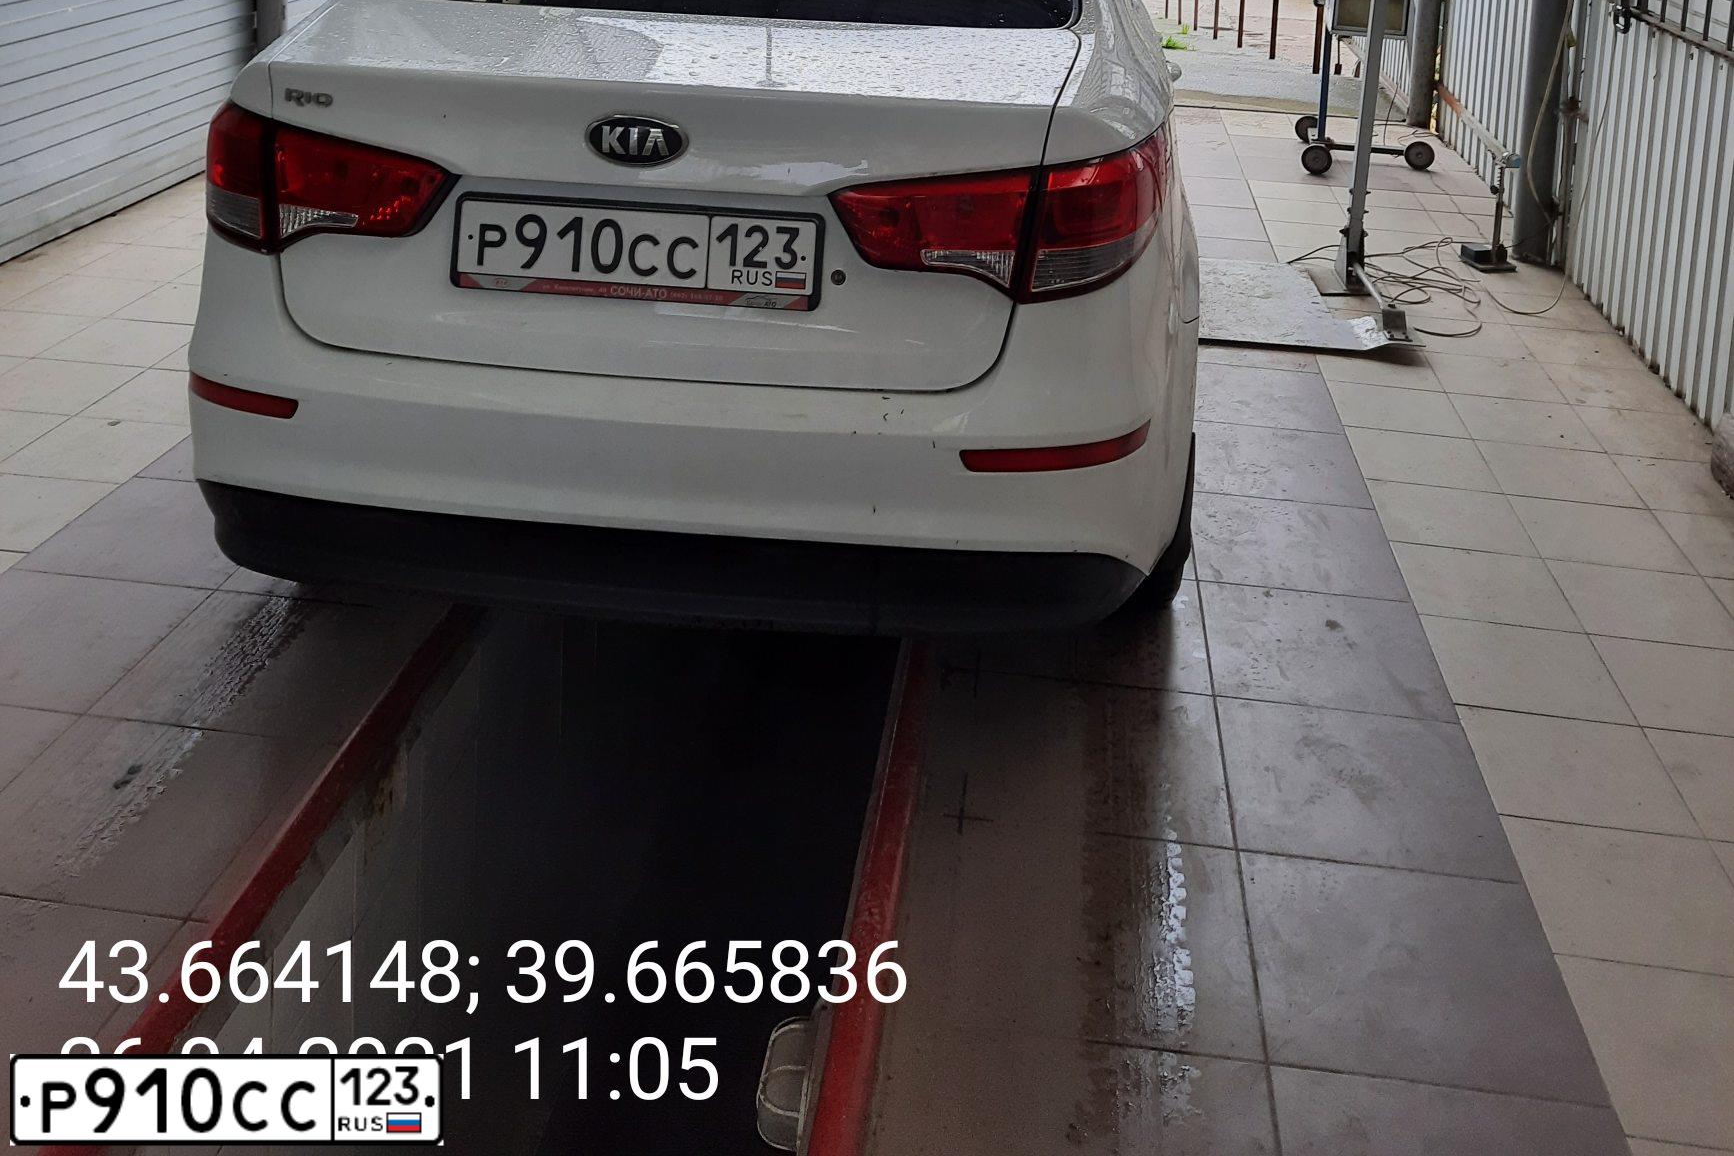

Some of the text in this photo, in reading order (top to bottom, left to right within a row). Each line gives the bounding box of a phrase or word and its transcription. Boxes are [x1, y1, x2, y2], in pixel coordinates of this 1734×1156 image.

[283, 87, 334, 108] RIO
[600, 125, 670, 156] KIA
[716, 224, 799, 270] 123
[731, 269, 773, 287] RUS
